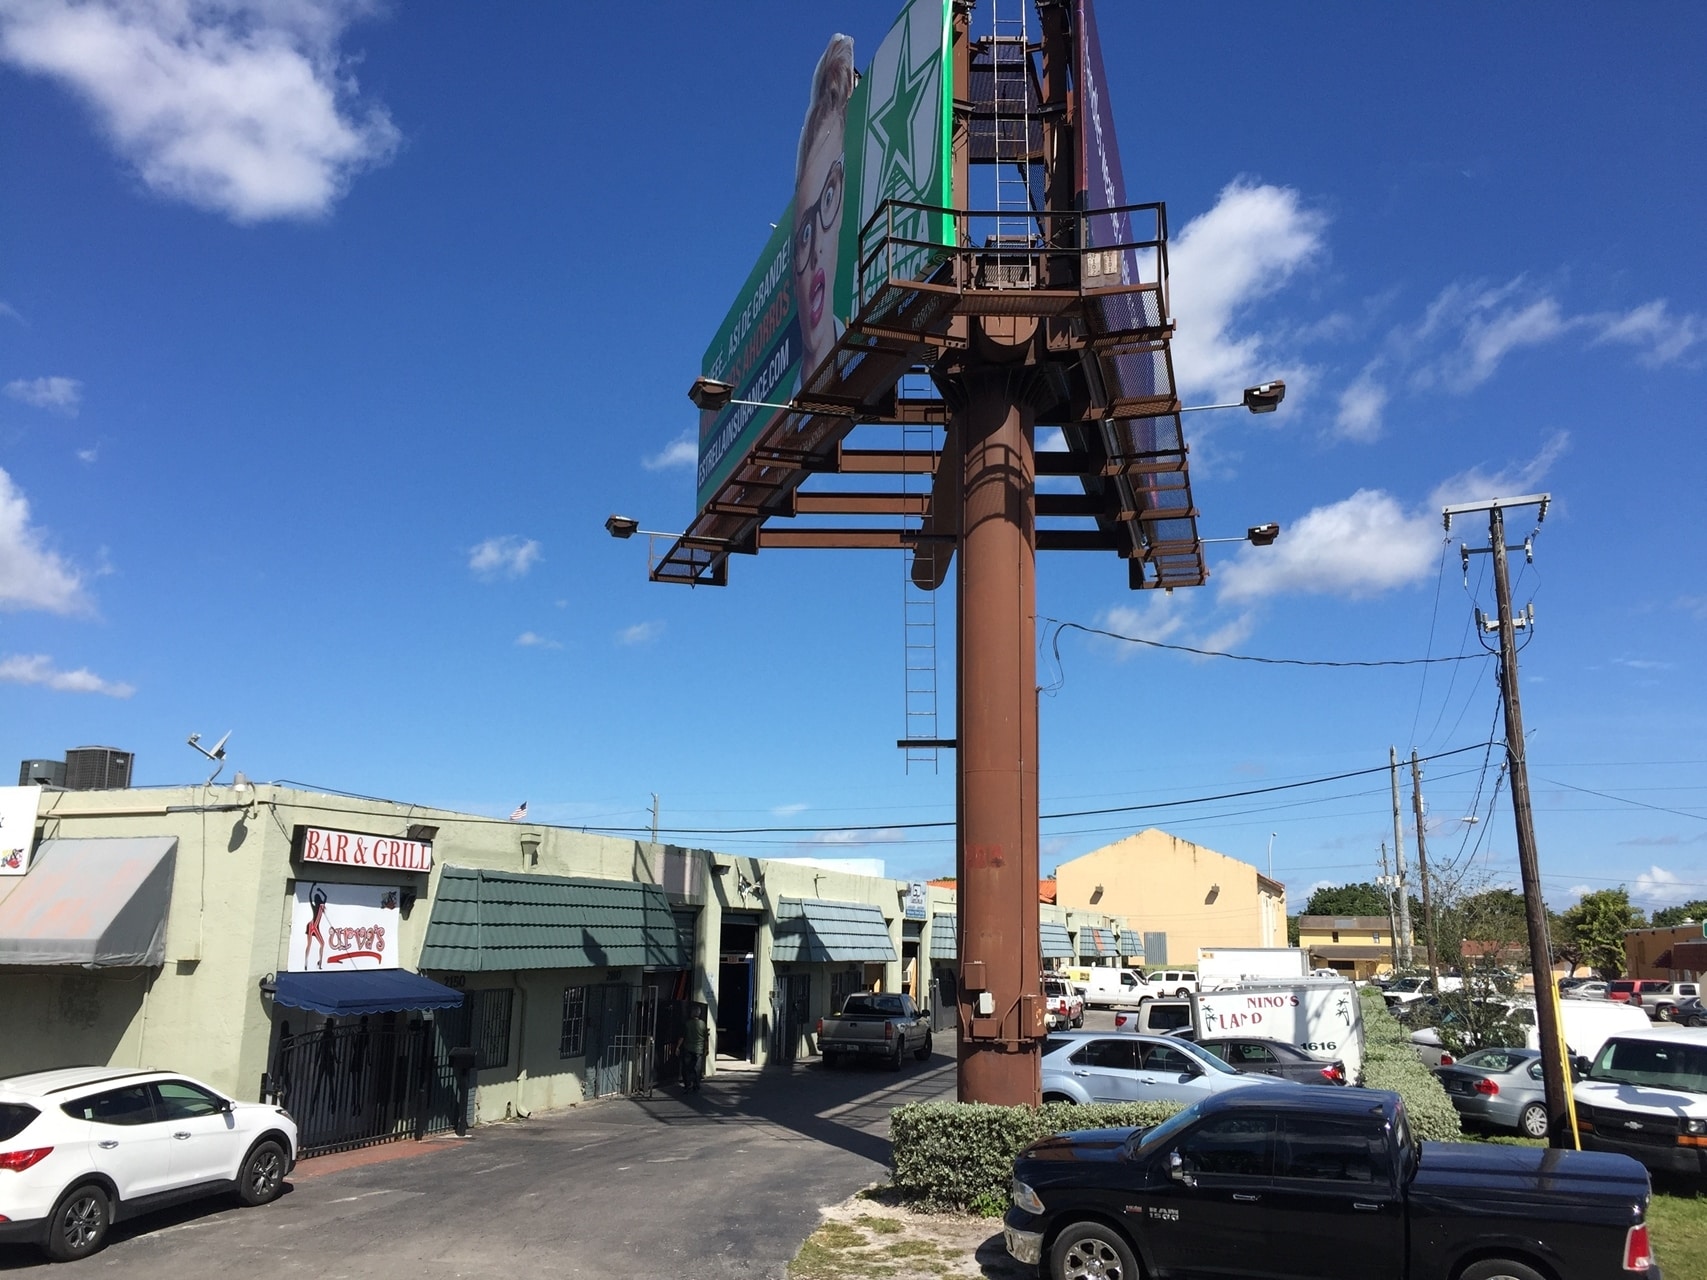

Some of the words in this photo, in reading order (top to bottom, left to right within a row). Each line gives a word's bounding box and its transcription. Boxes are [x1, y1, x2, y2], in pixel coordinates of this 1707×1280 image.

[753, 235, 791, 320] GRANDE!
[851, 248, 929, 323] INSANCE
[698, 338, 789, 488] ESTRELLAINSURANCE.COM
[305, 830, 349, 864] BAR
[354, 837, 368, 865] &
[373, 839, 431, 871] GRILL
[1247, 995, 1299, 1008] NINO'S
[1300, 1041, 1337, 1051] 1616
[1149, 1206, 1179, 1215] RAM
[1149, 1213, 1179, 1221] 1500
